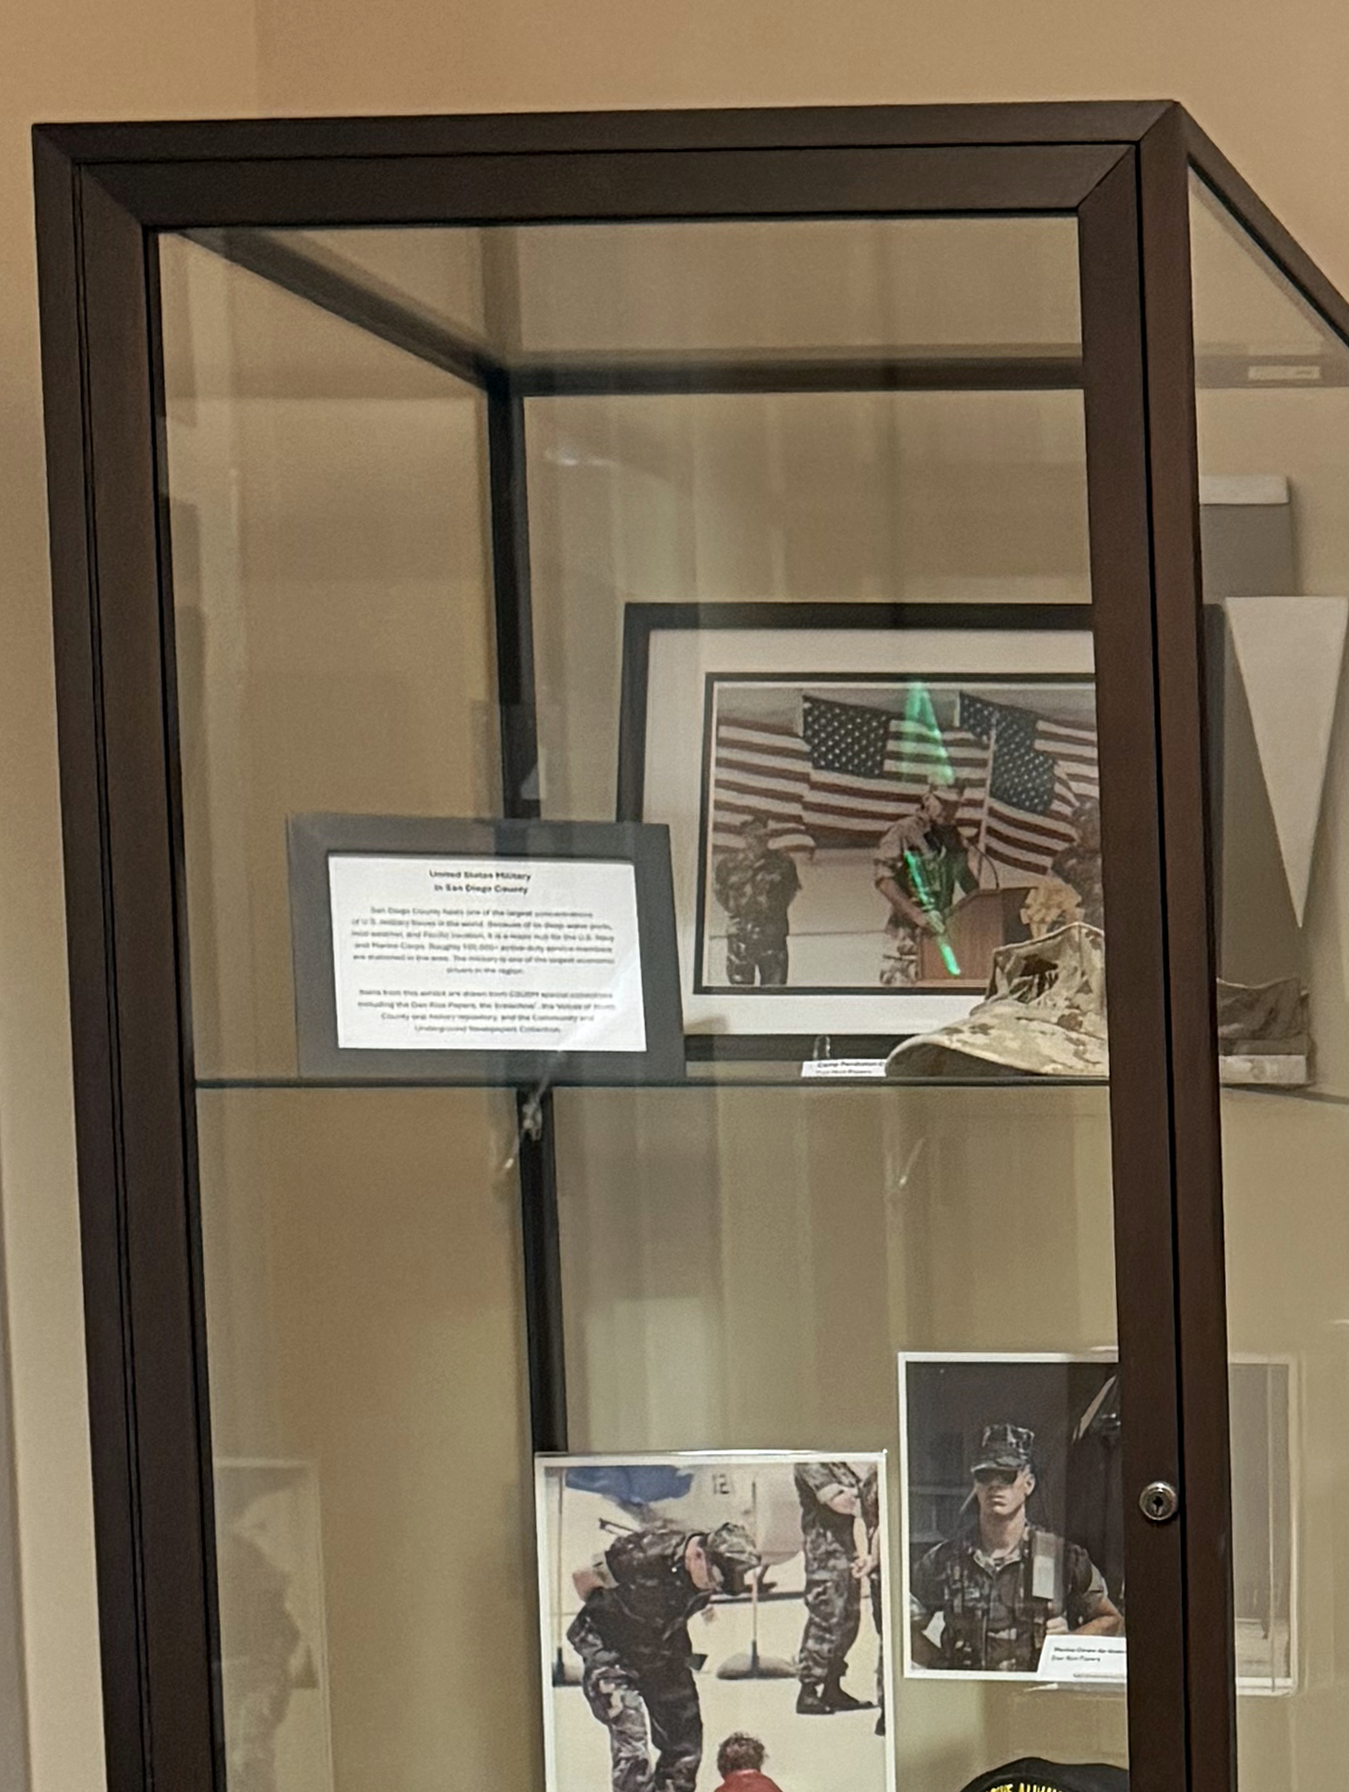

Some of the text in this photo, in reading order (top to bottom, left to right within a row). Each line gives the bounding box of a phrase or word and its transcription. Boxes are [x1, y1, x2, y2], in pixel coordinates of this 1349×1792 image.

[429, 869, 461, 878] United
[496, 871, 530, 881] Military
[446, 884, 463, 892] San
[465, 884, 492, 893] Diego
[495, 885, 528, 894] County
